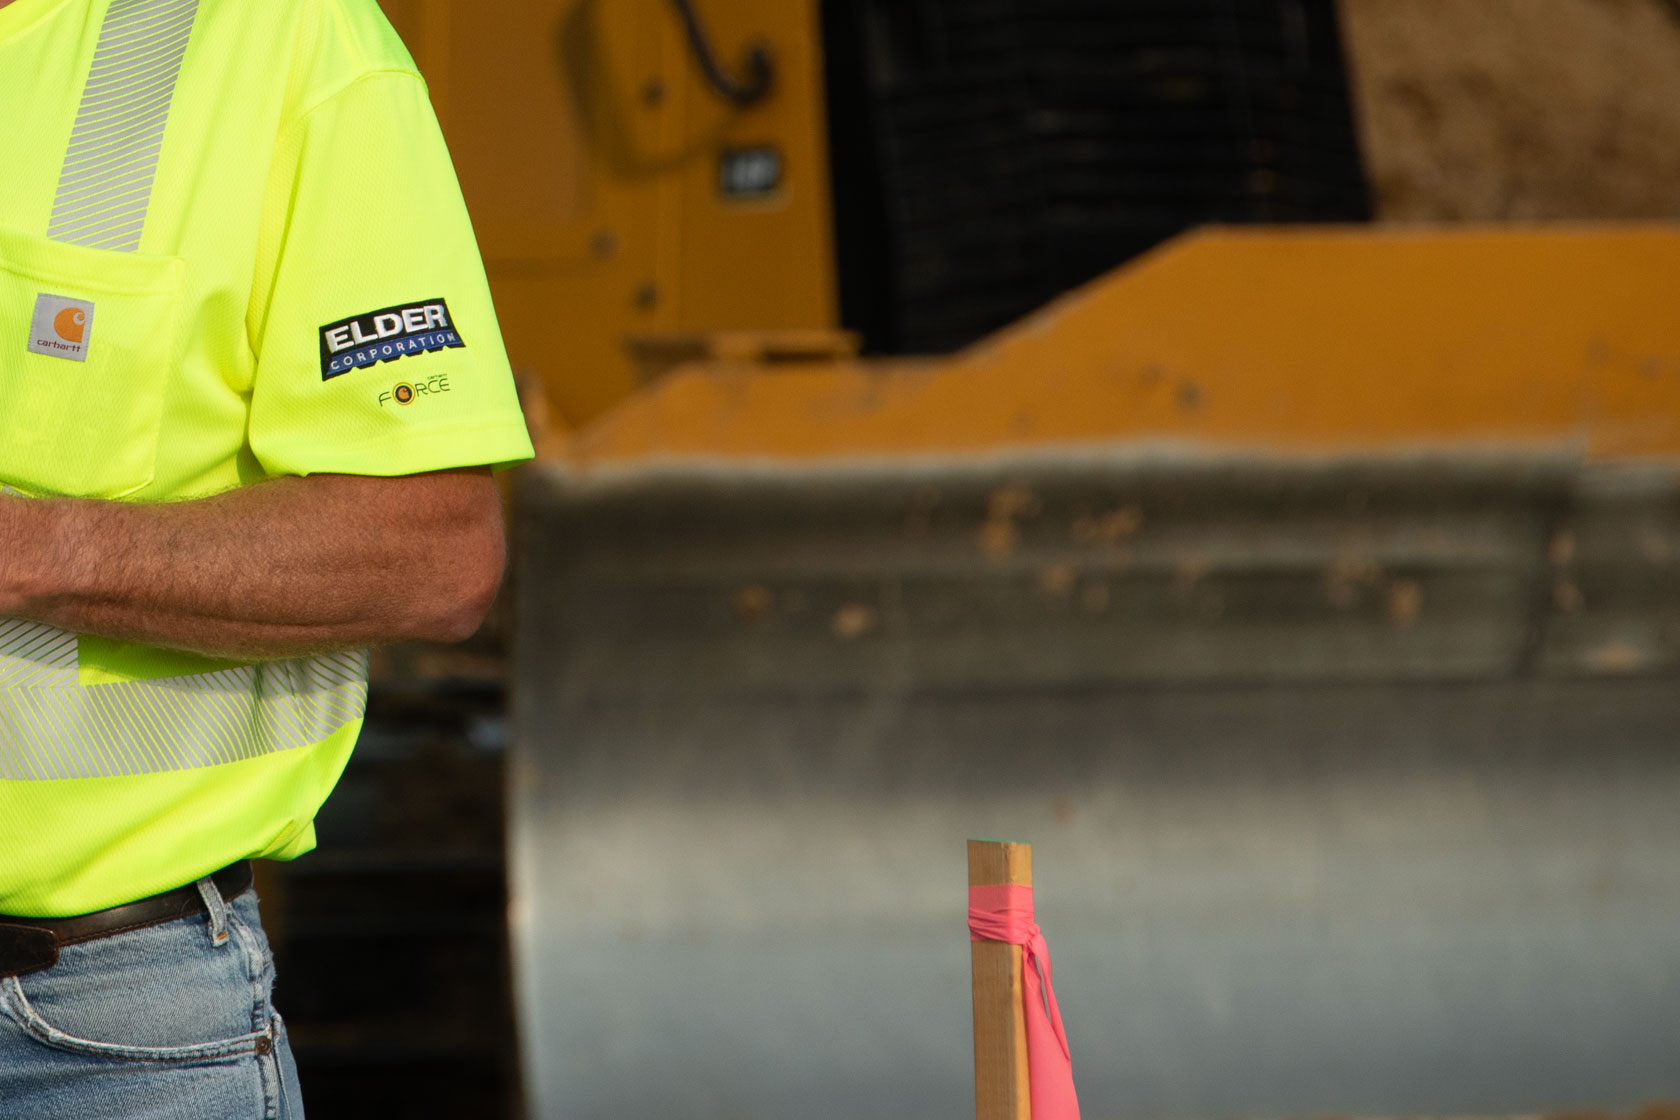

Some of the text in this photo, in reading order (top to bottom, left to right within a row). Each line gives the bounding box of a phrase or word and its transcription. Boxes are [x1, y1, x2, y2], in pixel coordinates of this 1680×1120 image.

[36, 339, 80, 352] carhartt
[324, 304, 448, 353] ELDER
[330, 332, 456, 370] CORPORATION
